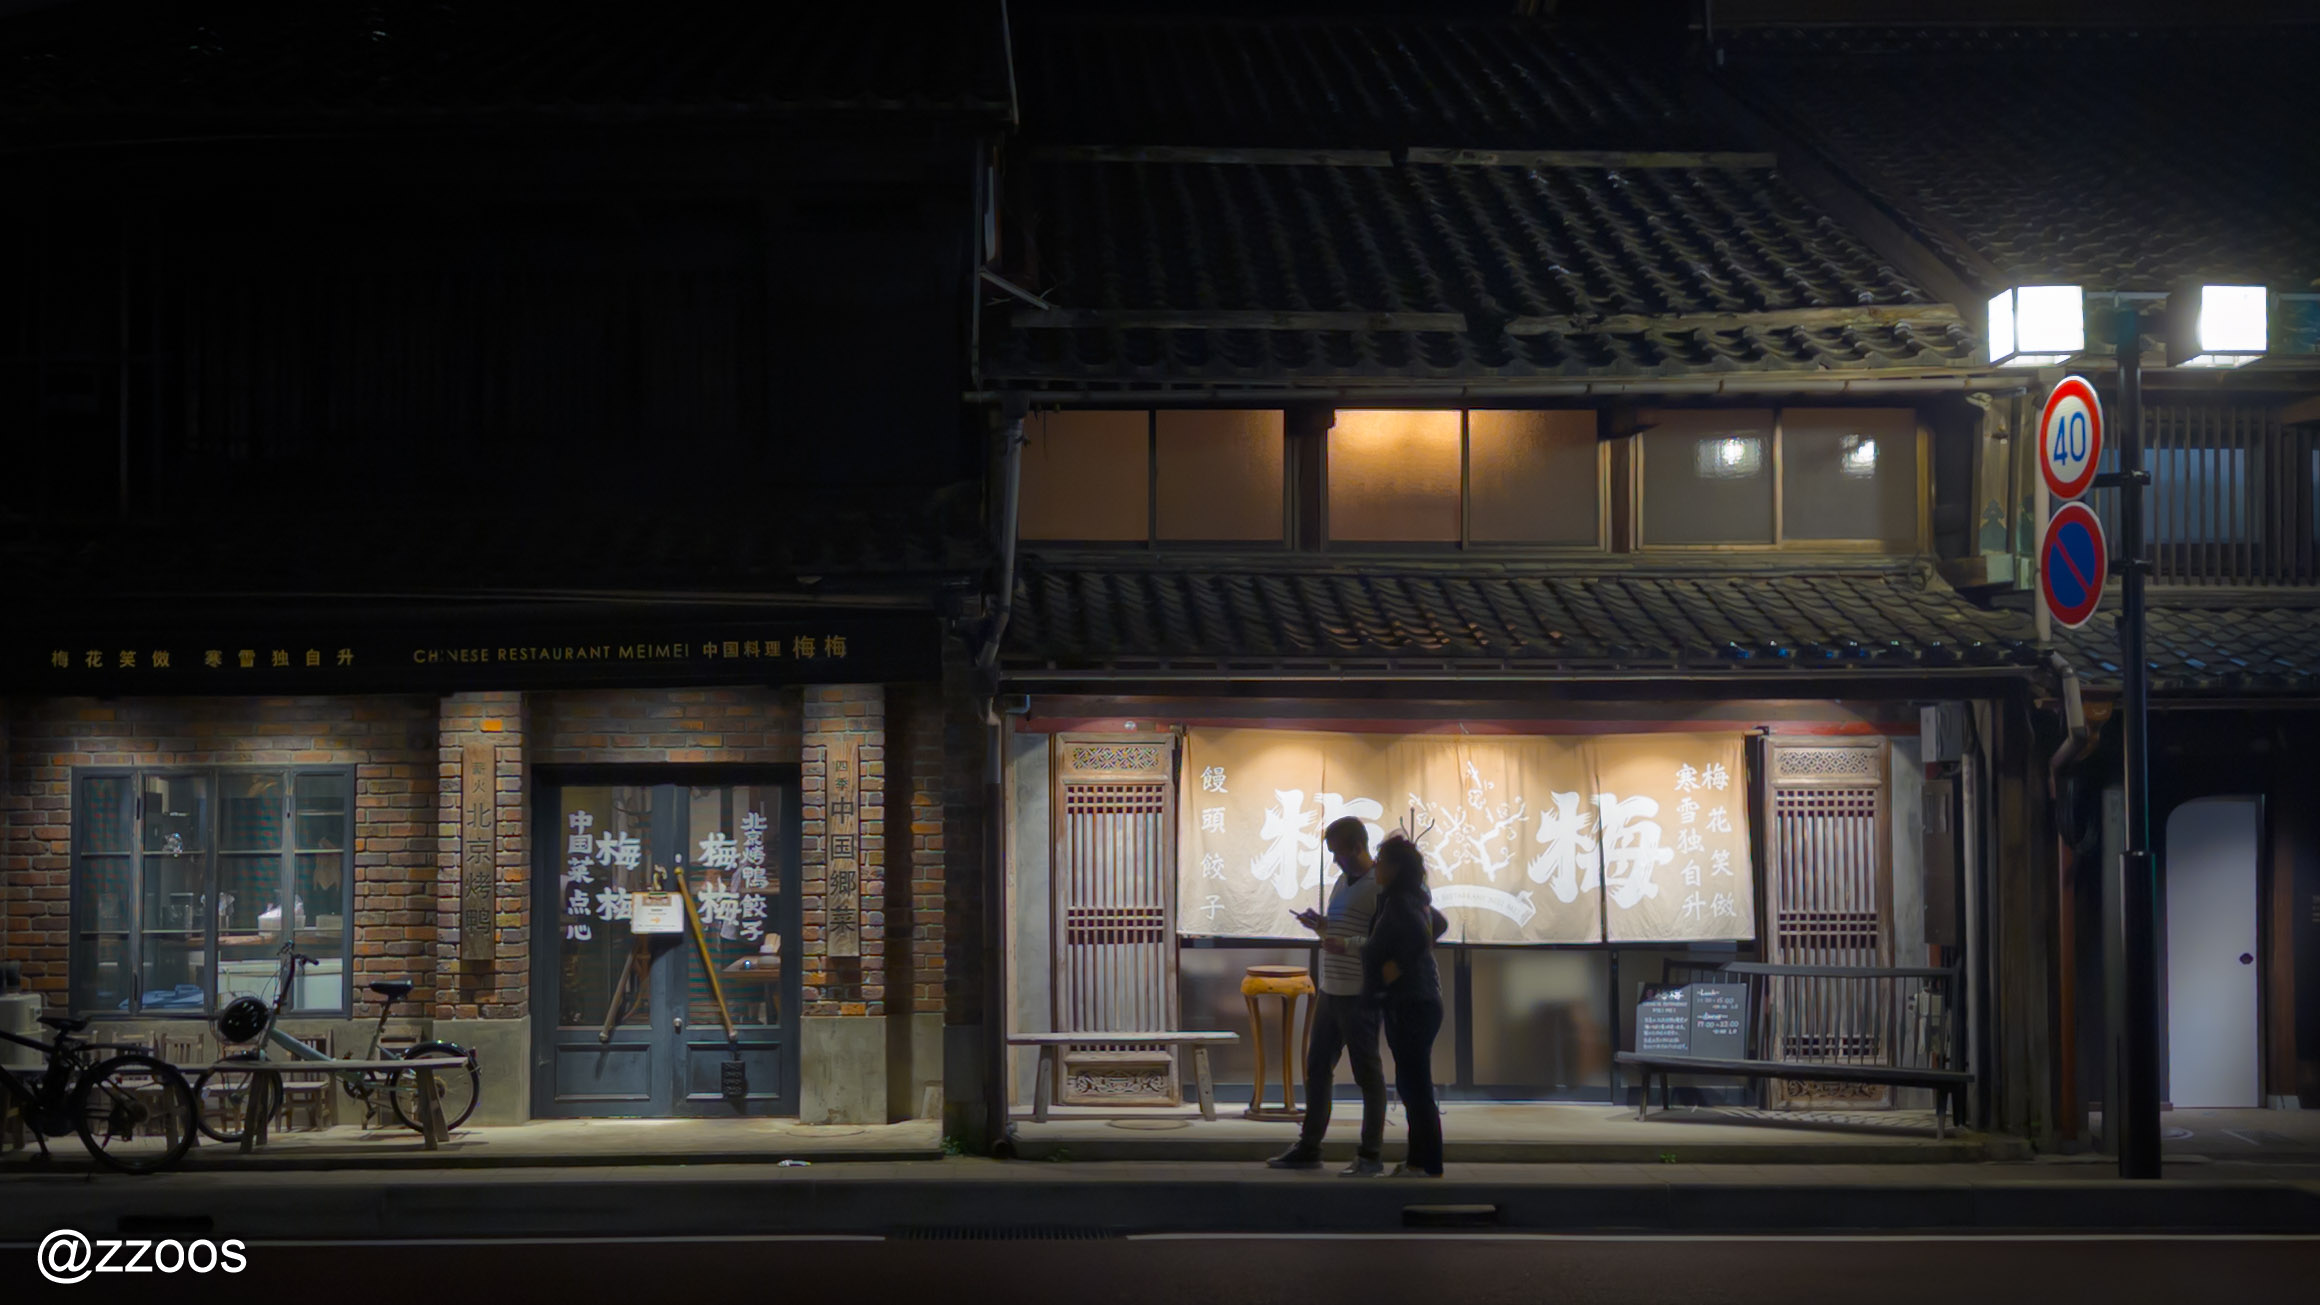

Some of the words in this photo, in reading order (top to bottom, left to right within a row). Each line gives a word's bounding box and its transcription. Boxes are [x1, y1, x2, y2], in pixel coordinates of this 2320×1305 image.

[2053, 411, 2087, 466] 40
[497, 645, 611, 662] RESTAURANT
[618, 642, 691, 660] MEIMEI
[702, 640, 782, 660] 中国料理
[792, 634, 848, 660] 梅梅
